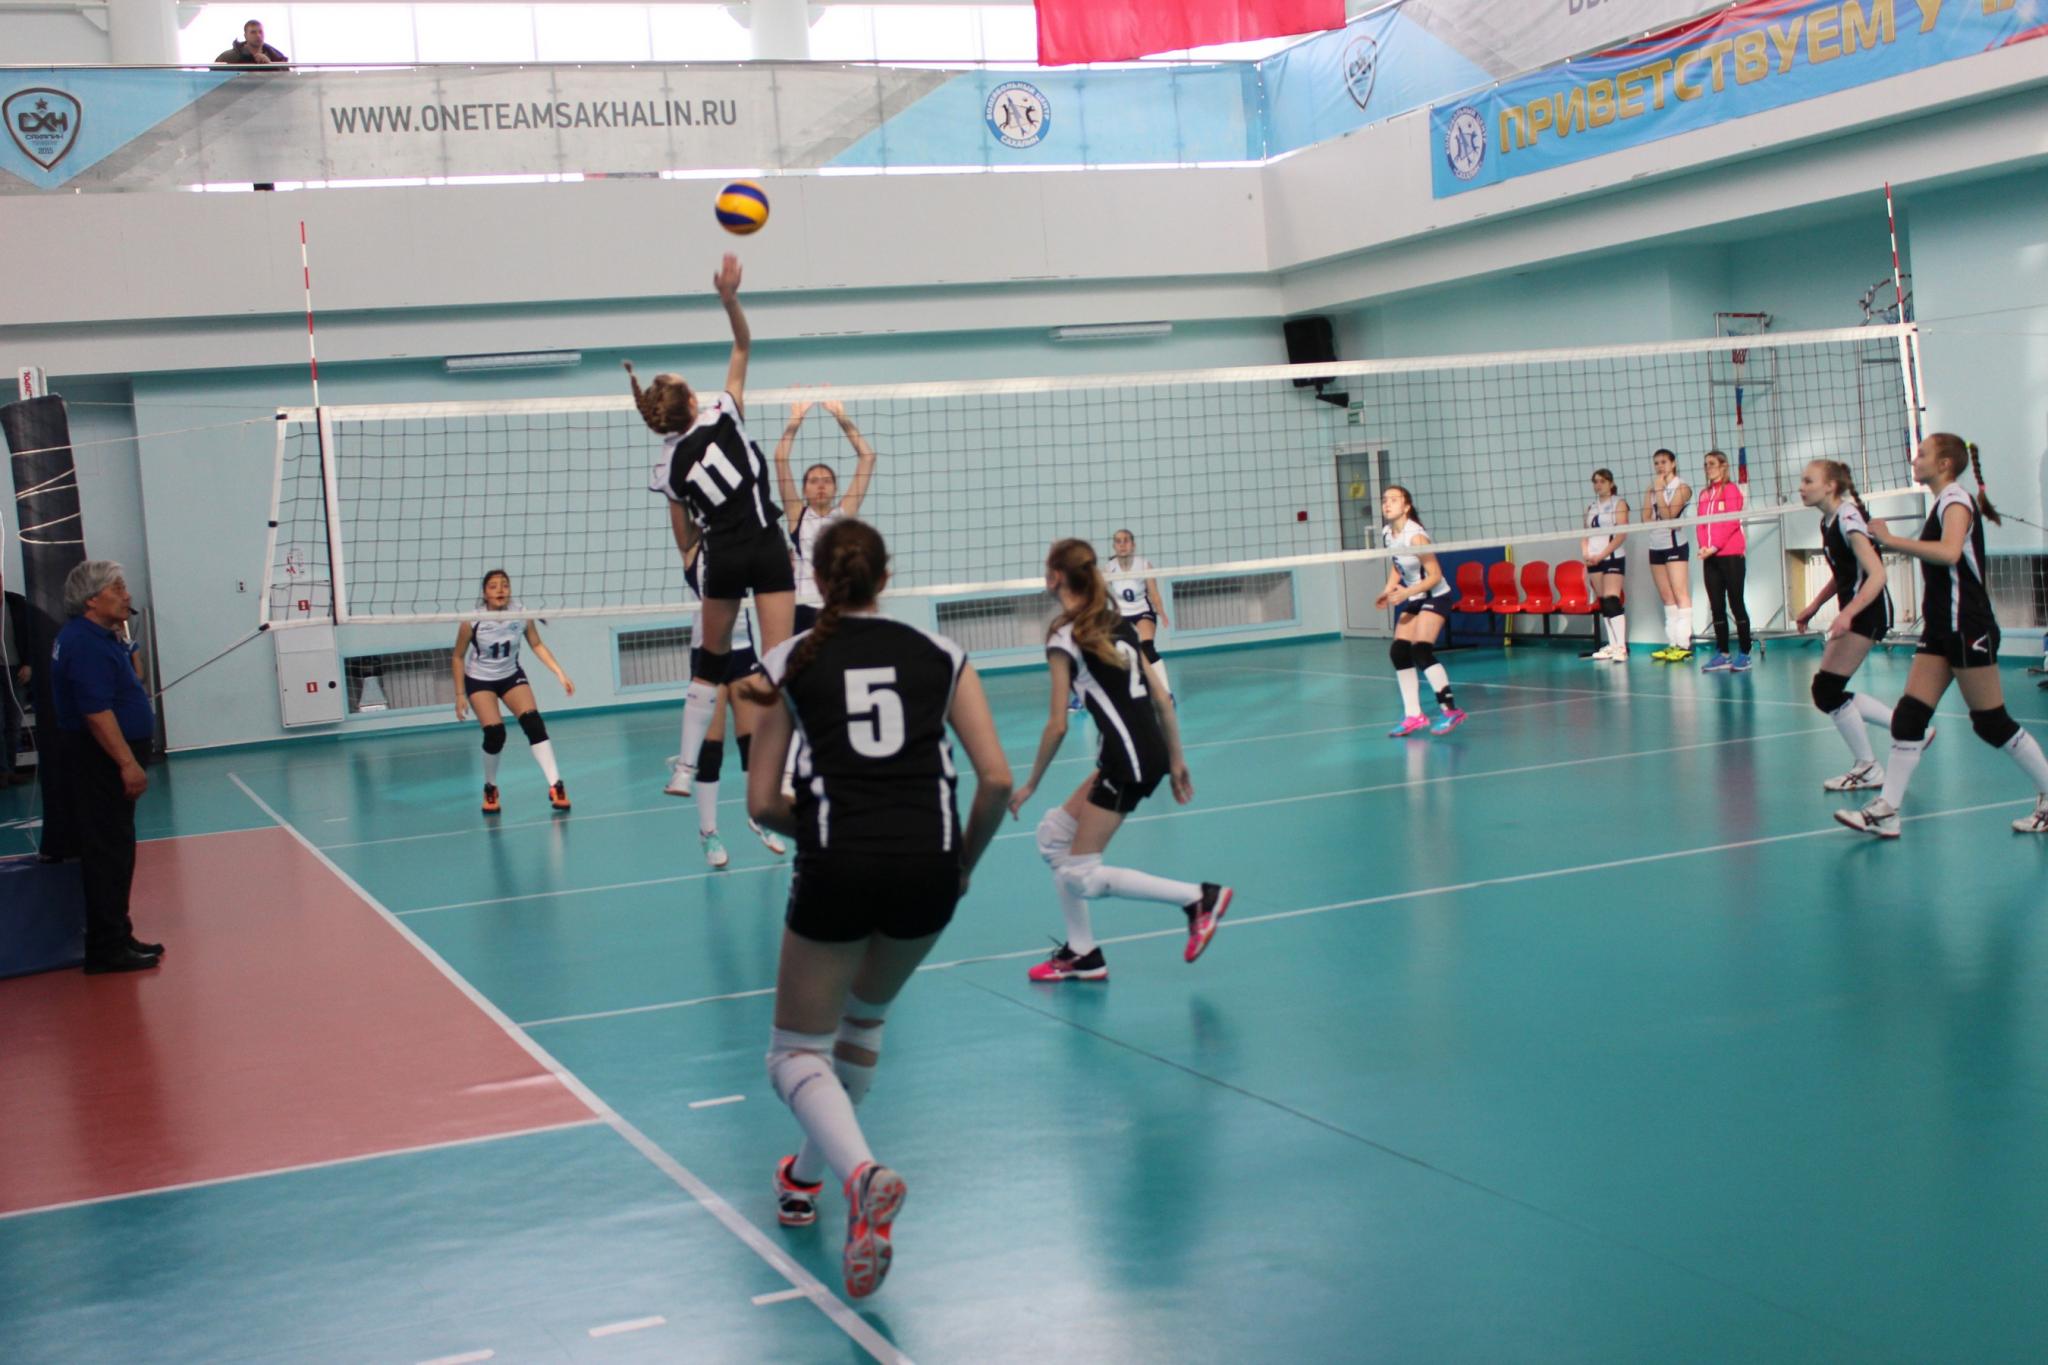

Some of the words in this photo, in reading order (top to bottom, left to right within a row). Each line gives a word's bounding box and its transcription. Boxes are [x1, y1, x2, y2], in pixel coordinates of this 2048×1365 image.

[1499, 0, 1896, 154] ПРИВЕТСТВУЕМ
[331, 99, 738, 134] WWW.ONETEAMSAKHALIN.RU
[686, 441, 743, 507] 11
[488, 640, 511, 659] 11
[843, 665, 906, 759] 5
